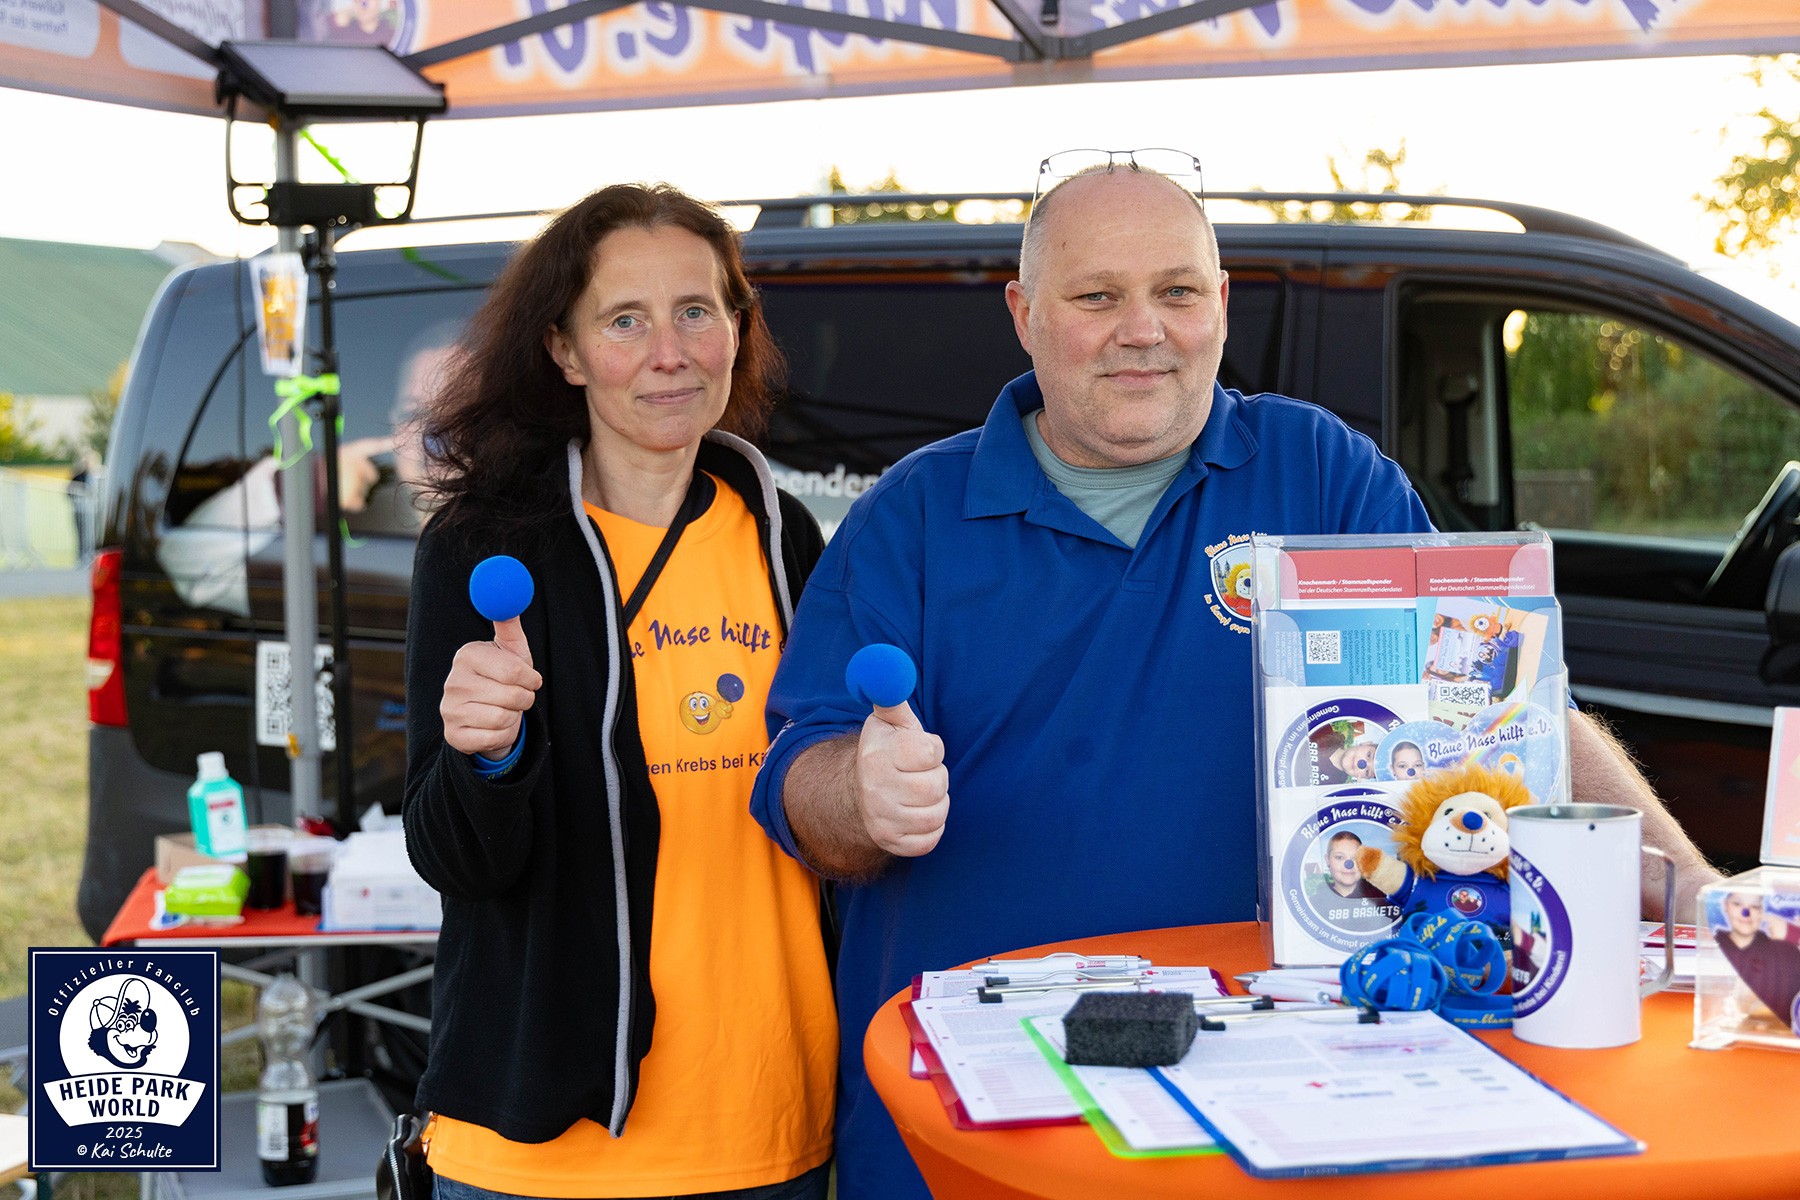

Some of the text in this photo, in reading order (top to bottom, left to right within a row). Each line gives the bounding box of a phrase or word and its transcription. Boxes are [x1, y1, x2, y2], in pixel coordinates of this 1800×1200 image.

[648, 620, 712, 650] Nase
[720, 616, 772, 653] hilft
[1428, 741, 1462, 759] Blaue
[1466, 734, 1496, 751] Nase
[1498, 724, 1524, 742] hilft
[676, 758, 717, 773] Krebs
[722, 754, 744, 770] bei
[1300, 816, 1330, 839] Blaue
[1330, 808, 1358, 821] Nase
[1289, 888, 1319, 932] Gemeinsam
[1318, 928, 1330, 939] im
[1330, 933, 1358, 948] Kampf
[1328, 905, 1400, 920] SBB BASKETS
